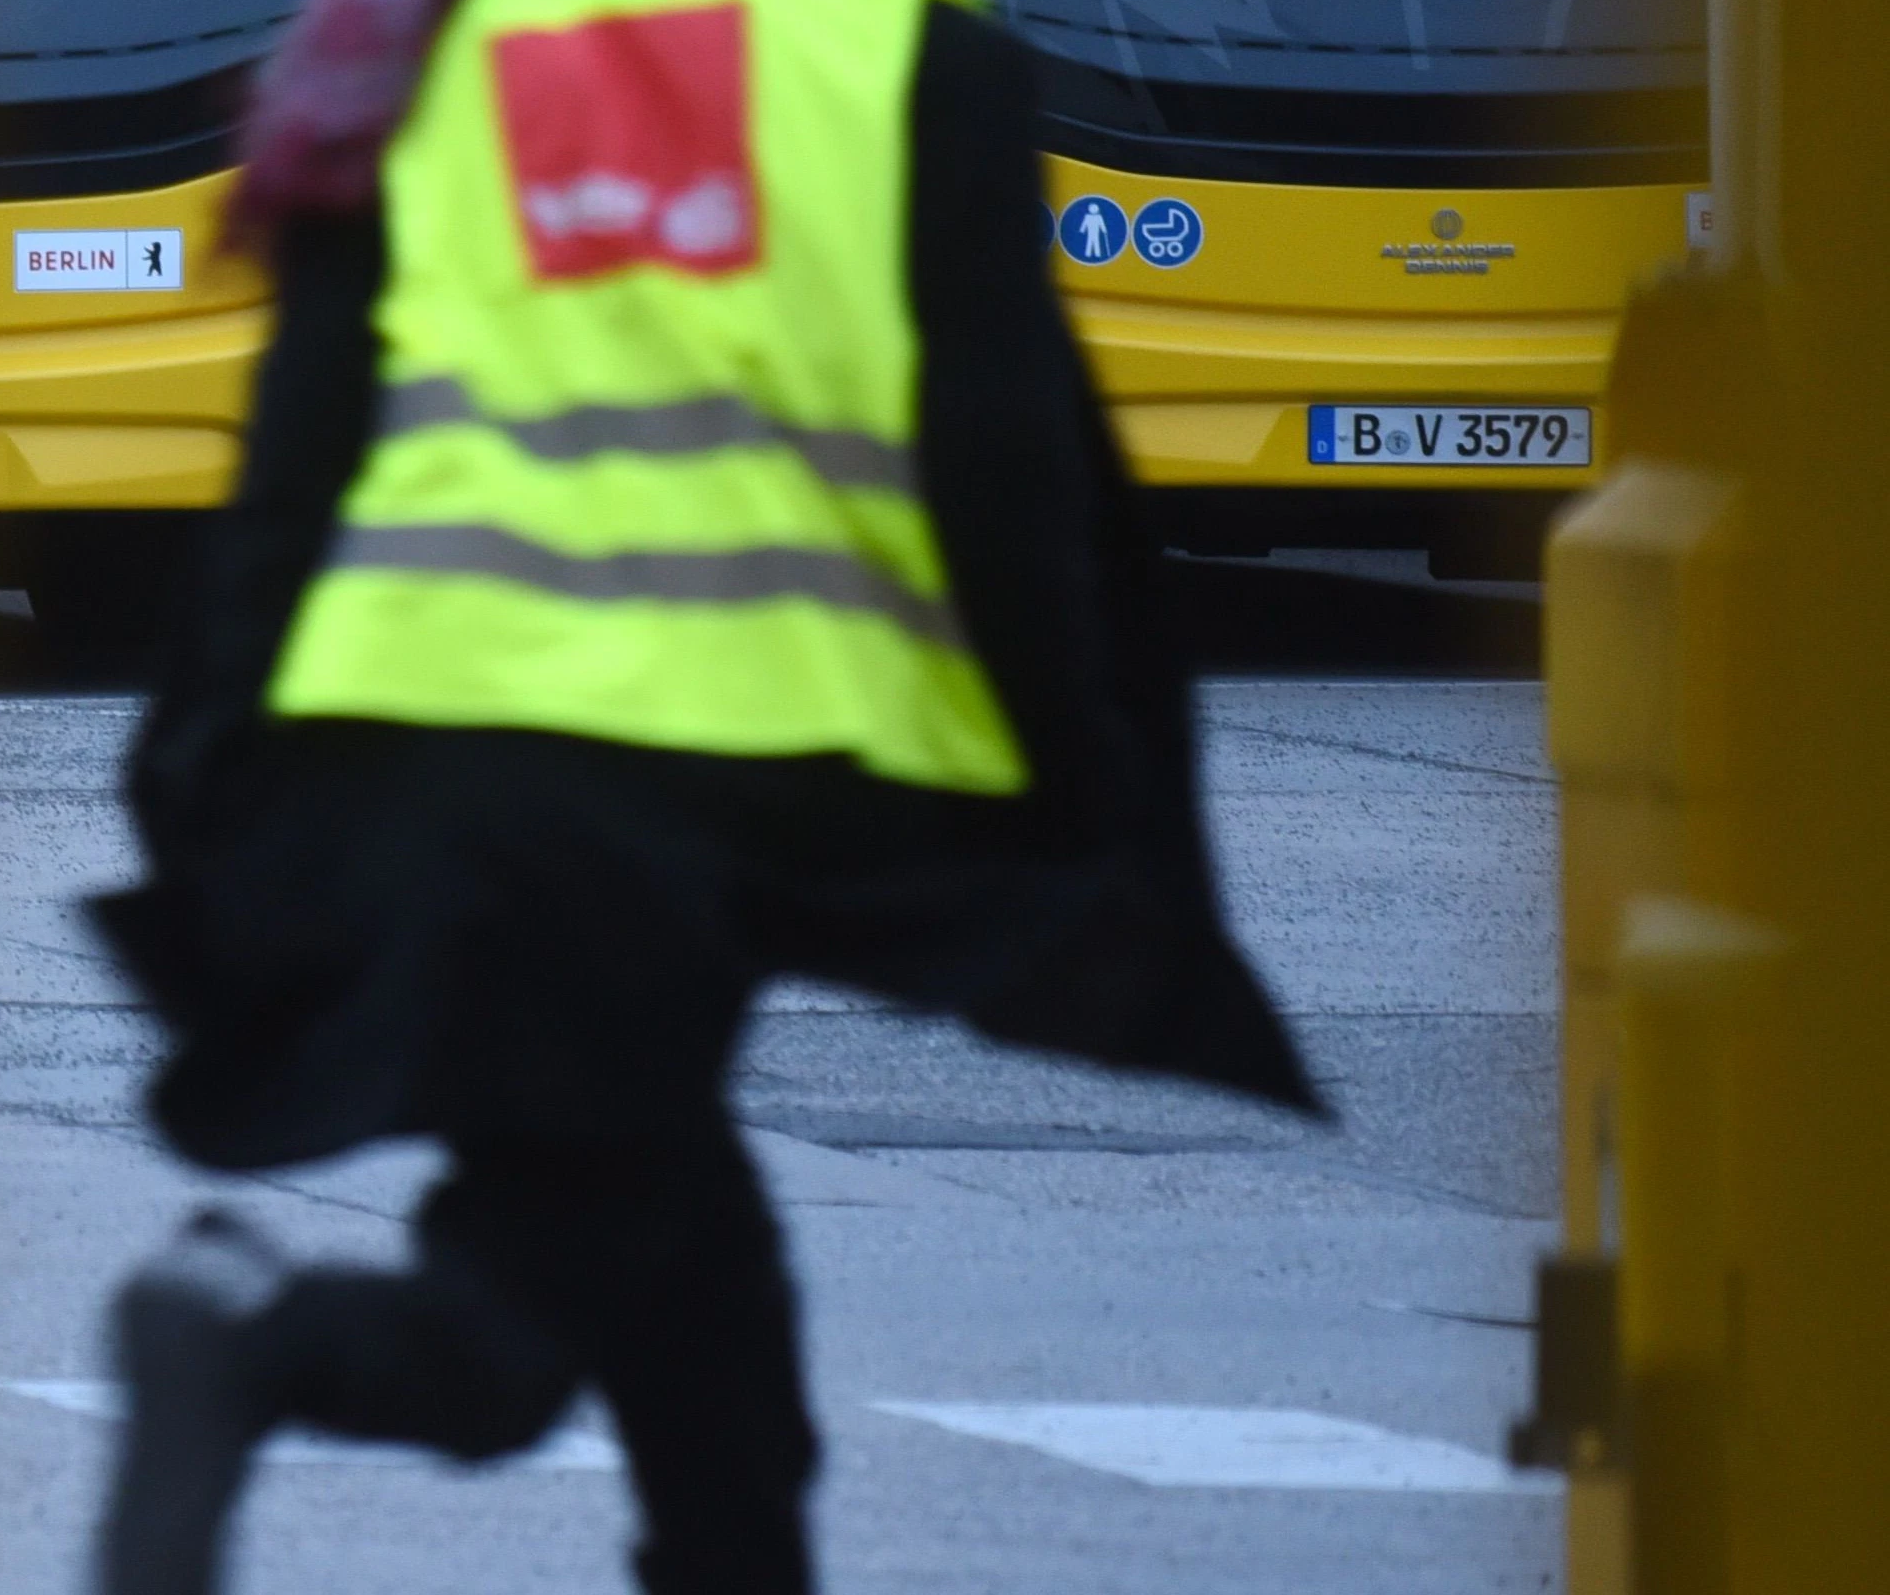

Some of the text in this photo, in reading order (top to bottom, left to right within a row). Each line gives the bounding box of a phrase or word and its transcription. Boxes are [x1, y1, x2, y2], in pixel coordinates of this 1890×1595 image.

[1382, 243, 1515, 259] ALEXANDER
[28, 250, 115, 271] BERLIN
[1405, 260, 1489, 275] DENNIS
[1354, 414, 1568, 457] B V 3579
